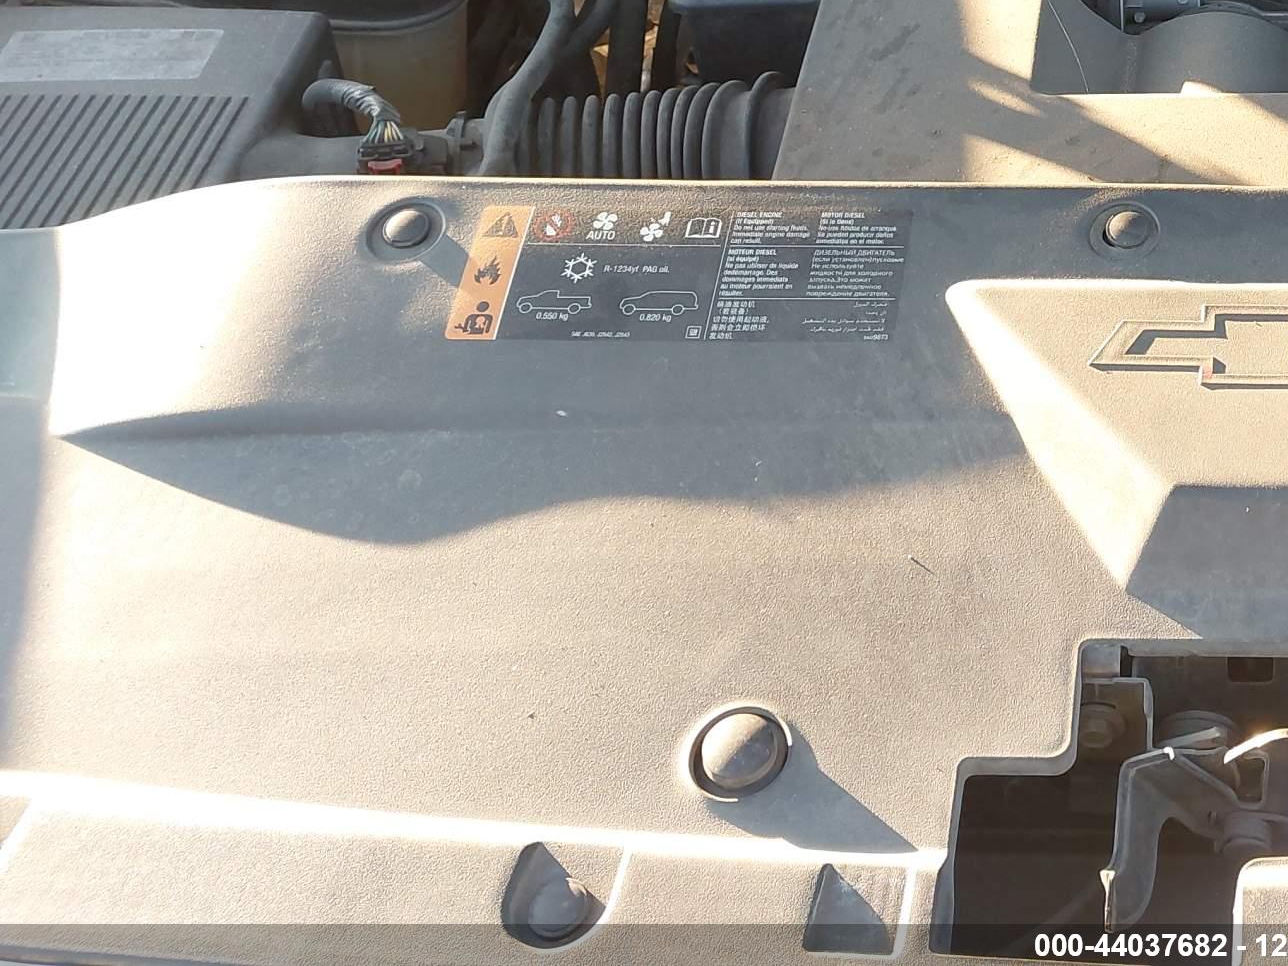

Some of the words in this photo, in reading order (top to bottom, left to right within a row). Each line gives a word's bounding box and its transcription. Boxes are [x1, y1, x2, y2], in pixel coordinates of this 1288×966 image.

[821, 211, 843, 219] MOTOR
[844, 211, 866, 219] DIESEL
[586, 230, 616, 240] AUTO
[727, 248, 754, 256] MOTEUR
[755, 248, 777, 256] DIESEL
[603, 265, 640, 274] R-1234yf
[535, 312, 558, 320] 0.550
[559, 312, 569, 321] kg
[639, 313, 661, 321] 0.820
[662, 313, 672, 322] kg
